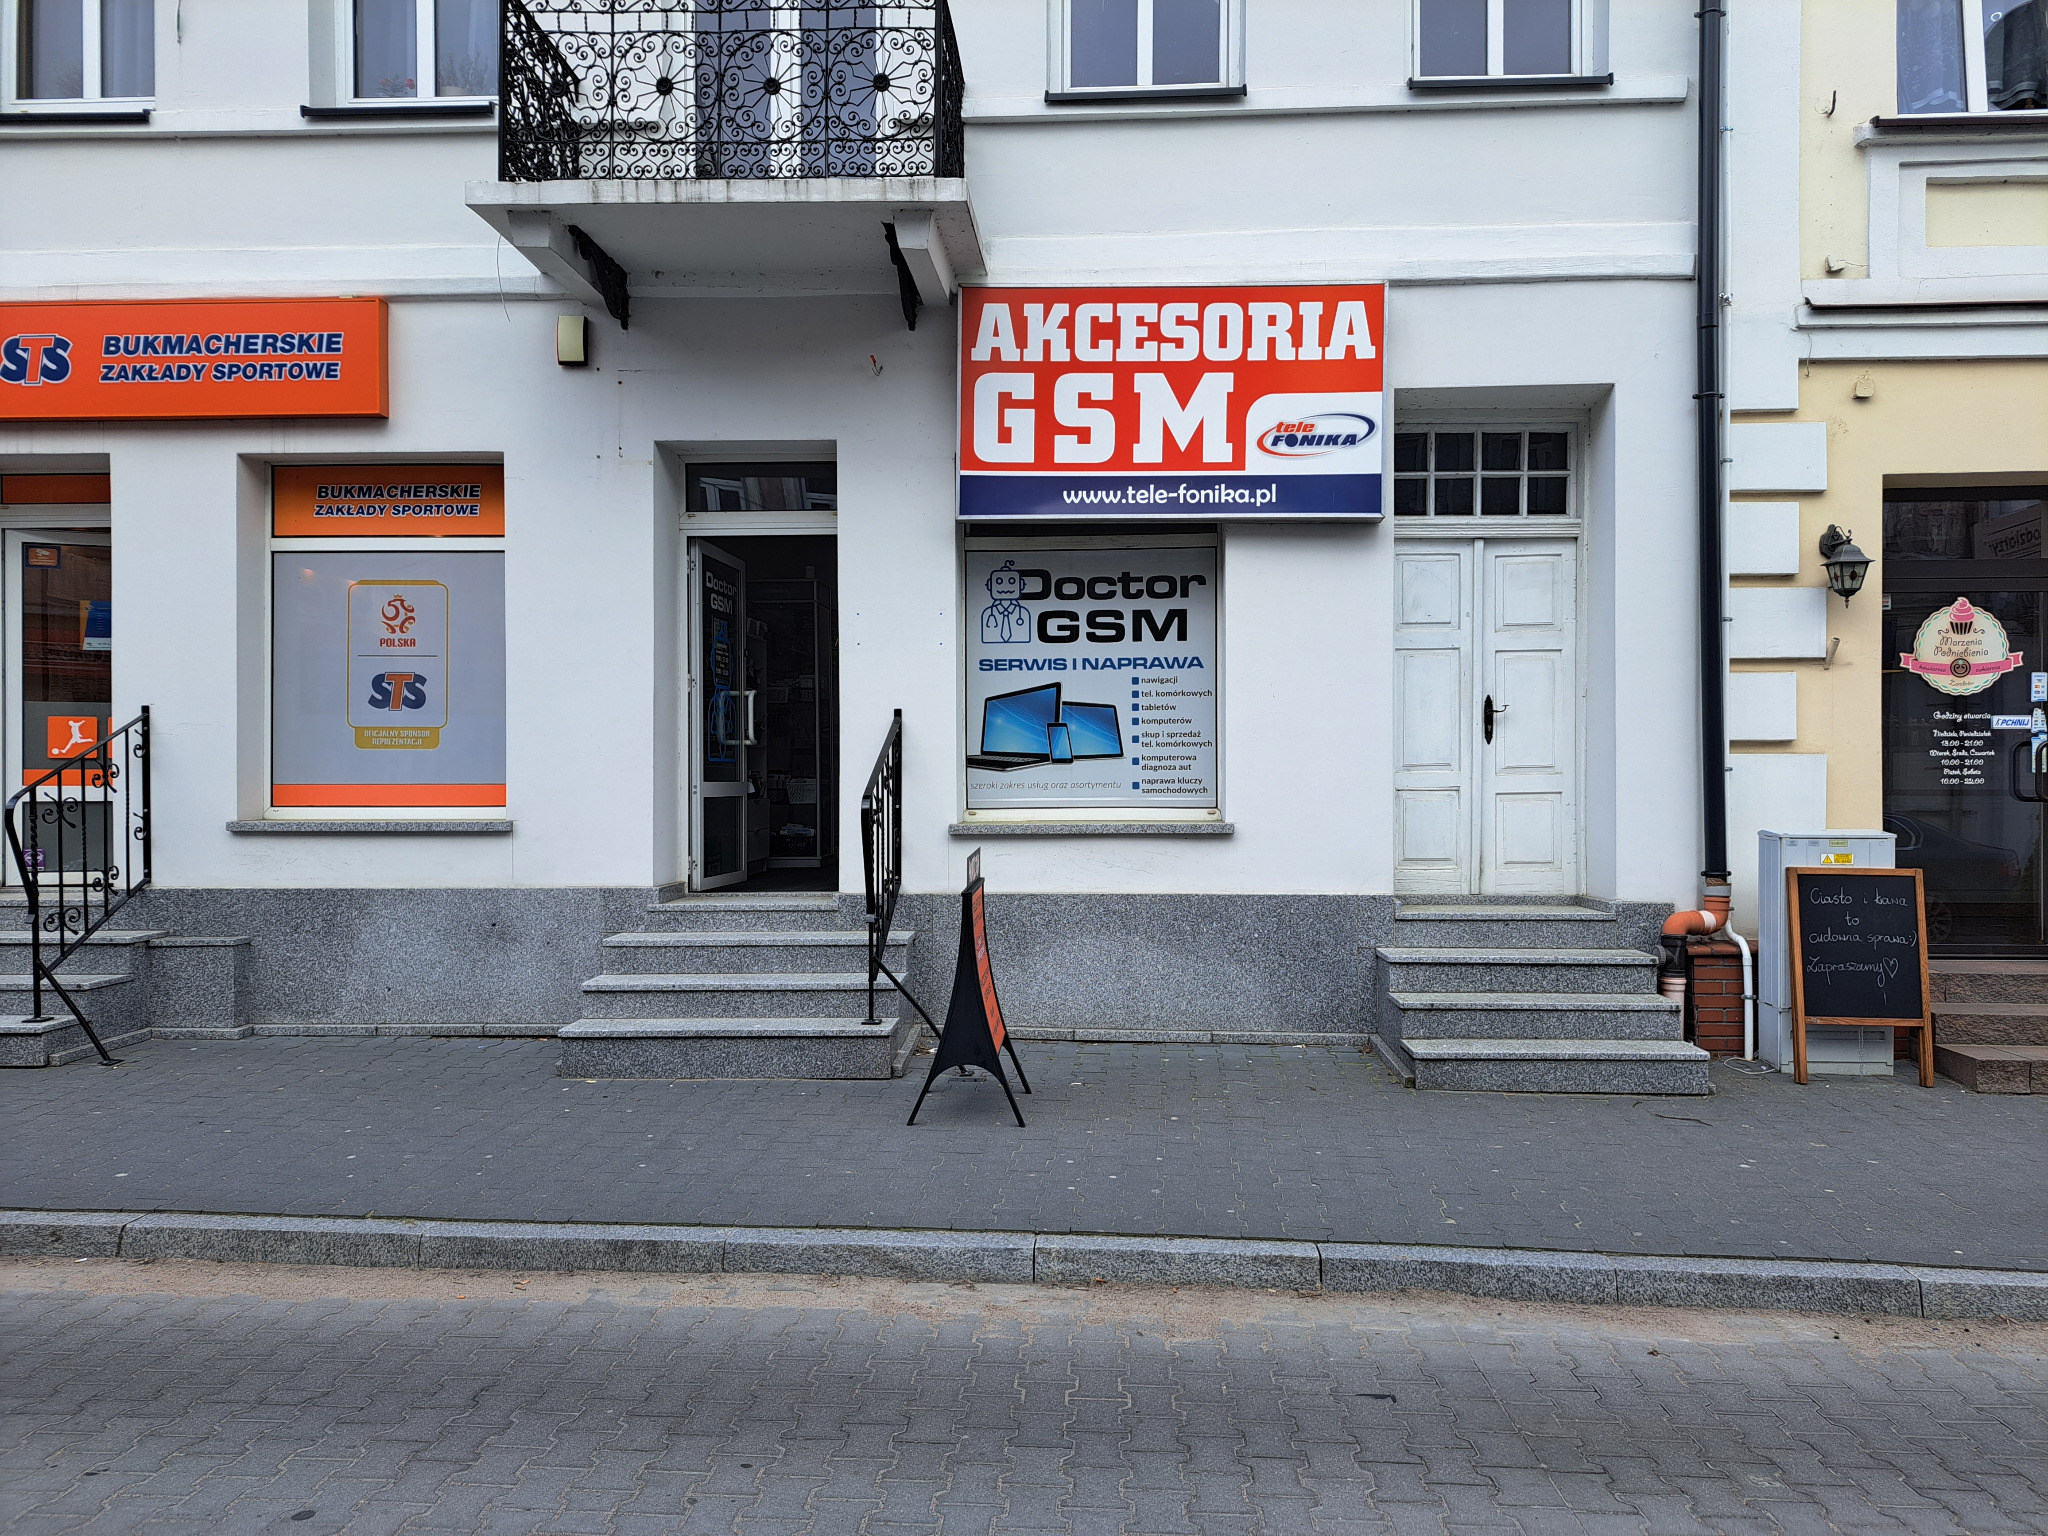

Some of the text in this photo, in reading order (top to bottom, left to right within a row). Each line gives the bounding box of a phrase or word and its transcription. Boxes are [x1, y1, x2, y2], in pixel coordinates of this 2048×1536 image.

[970, 300, 1377, 362] AKCESORIA
[102, 332, 344, 357] BUKMACHERSKIE
[0, 334, 73, 386] STS
[99, 361, 340, 383] ZAKŁADY SPORTOWE
[973, 372, 1235, 464] GSM
[1275, 421, 1316, 434] tele
[1270, 434, 1358, 447] FONIKA
[316, 484, 481, 500] BUKMACHERSKIE
[1062, 483, 1277, 507] www.tele-fonika.pl
[313, 503, 480, 518] ZAKŁADY SPORTOWE
[706, 571, 738, 597] Doctor
[1018, 568, 1207, 601] Doctor
[710, 592, 733, 615] GSM
[1037, 608, 1188, 644] GSM
[379, 637, 417, 648] POLSKA
[1939, 635, 1983, 646] Marzenia
[1933, 645, 1989, 658] Podniebienia
[978, 656, 1205, 672] SERWIS I NAPRAWA
[1141, 676, 1178, 685] nawigacji
[367, 672, 427, 711] STS
[1141, 689, 1213, 698] tel. komórkowych
[1141, 703, 1177, 711] tabletów
[1141, 717, 1192, 726] komputerów
[2000, 718, 2030, 727] PCHNIJ
[400, 730, 430, 738] SPONSOR
[1141, 731, 1160, 740] skup
[1166, 730, 1202, 740] sprzedaż
[1141, 740, 1213, 749] tel. komórkowych
[1141, 754, 1197, 764] komputerowa
[1141, 764, 1177, 773] diagnoza
[970, 779, 1122, 791] szeroki zakres usług oraz asortymentu
[1141, 777, 1203, 786] naprawa kluczy
[1141, 786, 1208, 796] samochodowych
[1810, 887, 1853, 905] Ciasto
[1845, 911, 1860, 926] to
[1806, 956, 1885, 987] Zapraszamy
